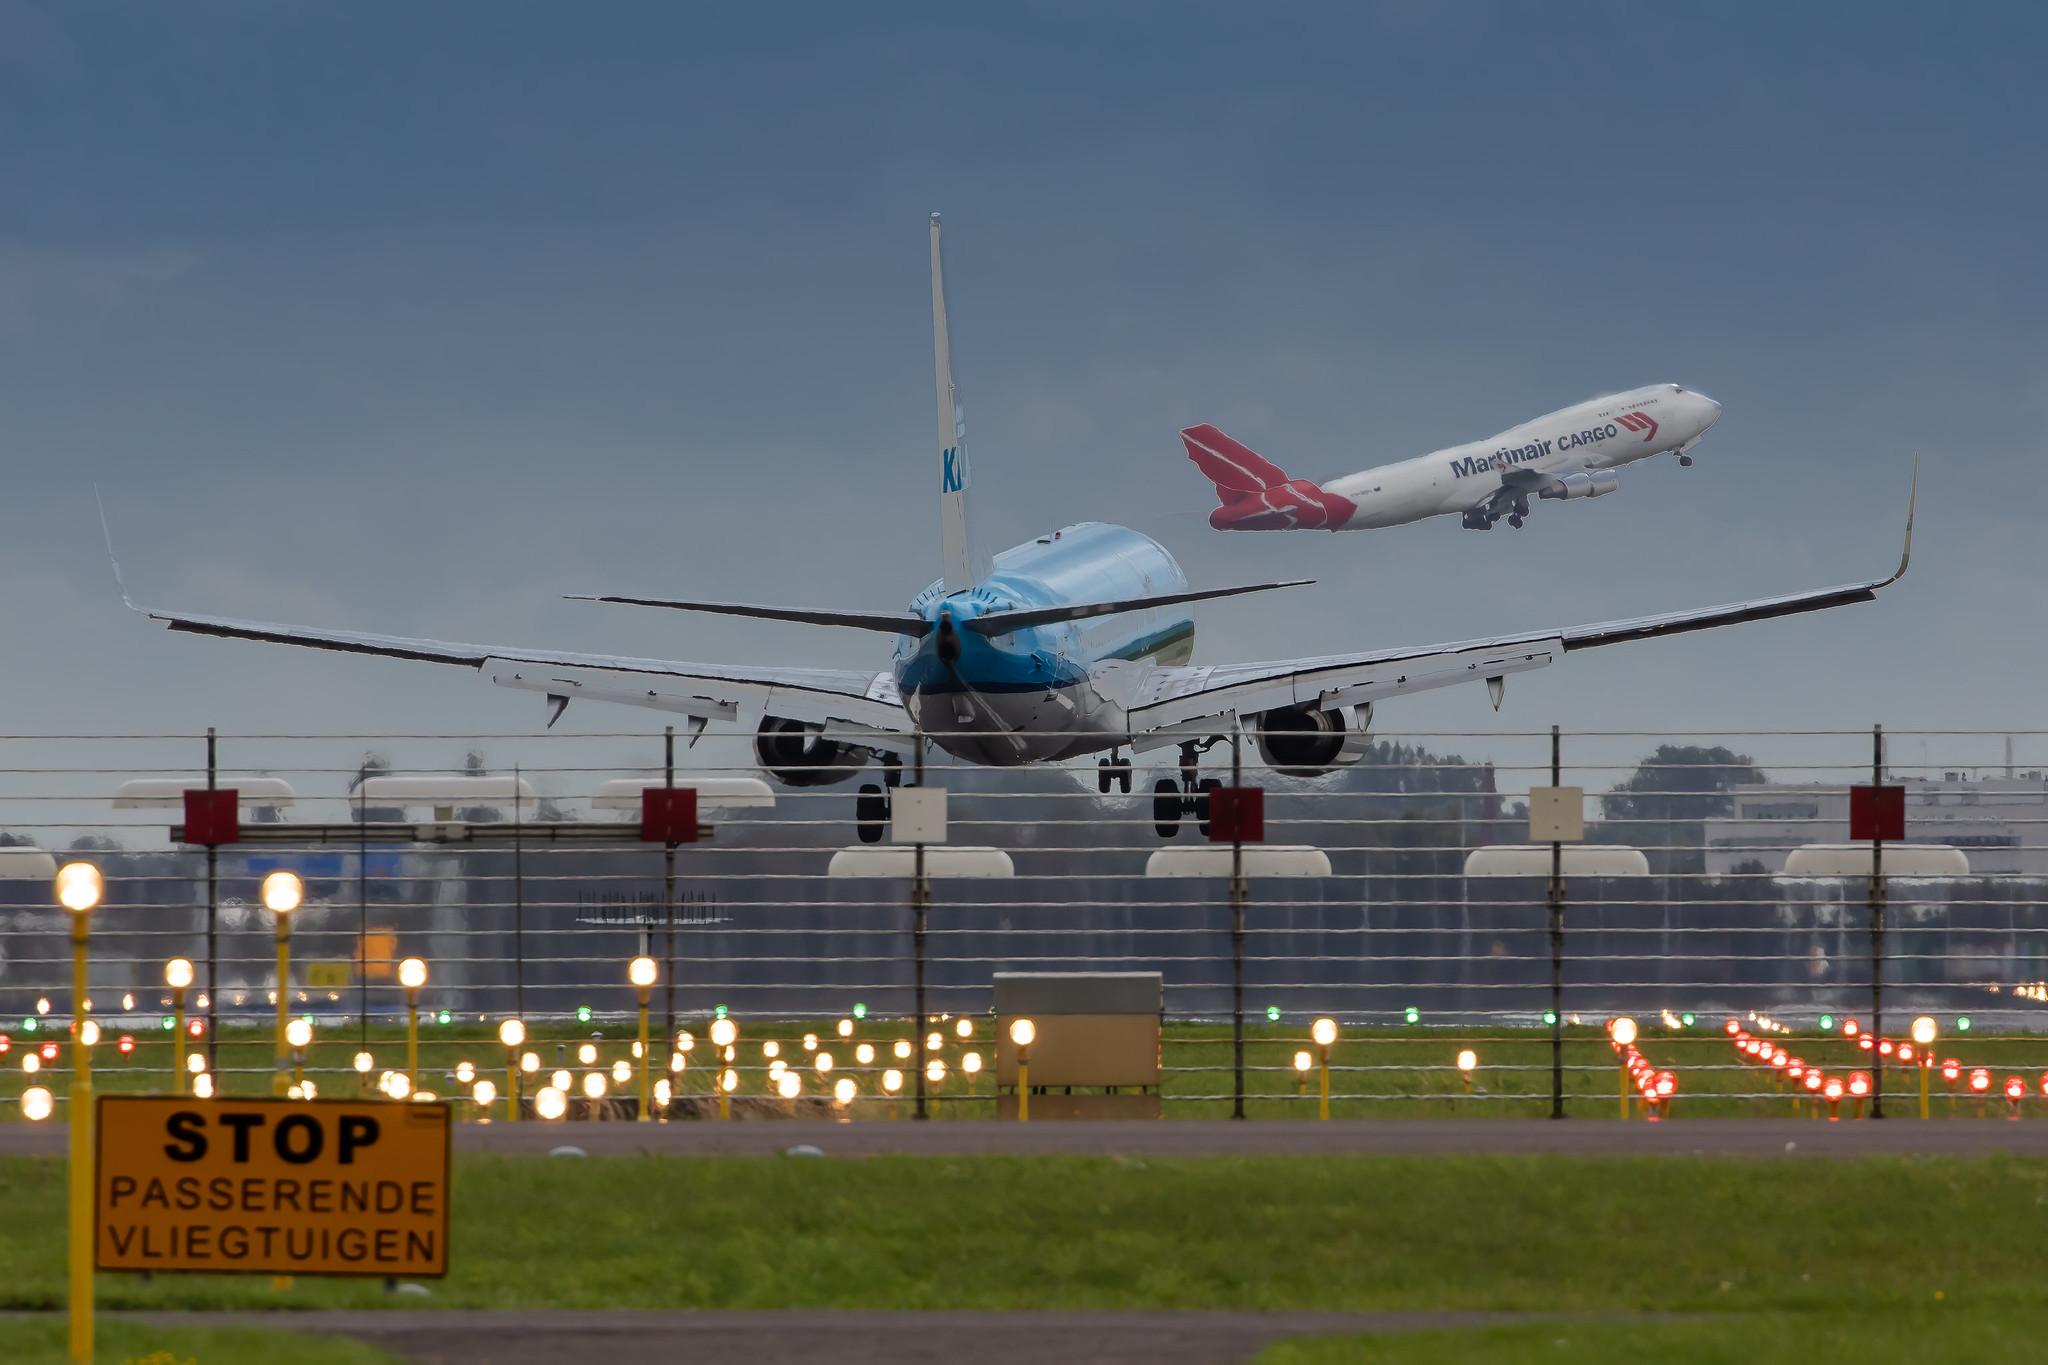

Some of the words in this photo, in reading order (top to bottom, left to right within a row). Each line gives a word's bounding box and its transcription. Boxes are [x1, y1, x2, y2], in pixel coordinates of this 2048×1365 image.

[1557, 423, 1618, 451] CARGO
[163, 1111, 380, 1164] STOP
[110, 1176, 436, 1216] PASSERENDE
[108, 1225, 435, 1263] VLIEGTUIGEN
